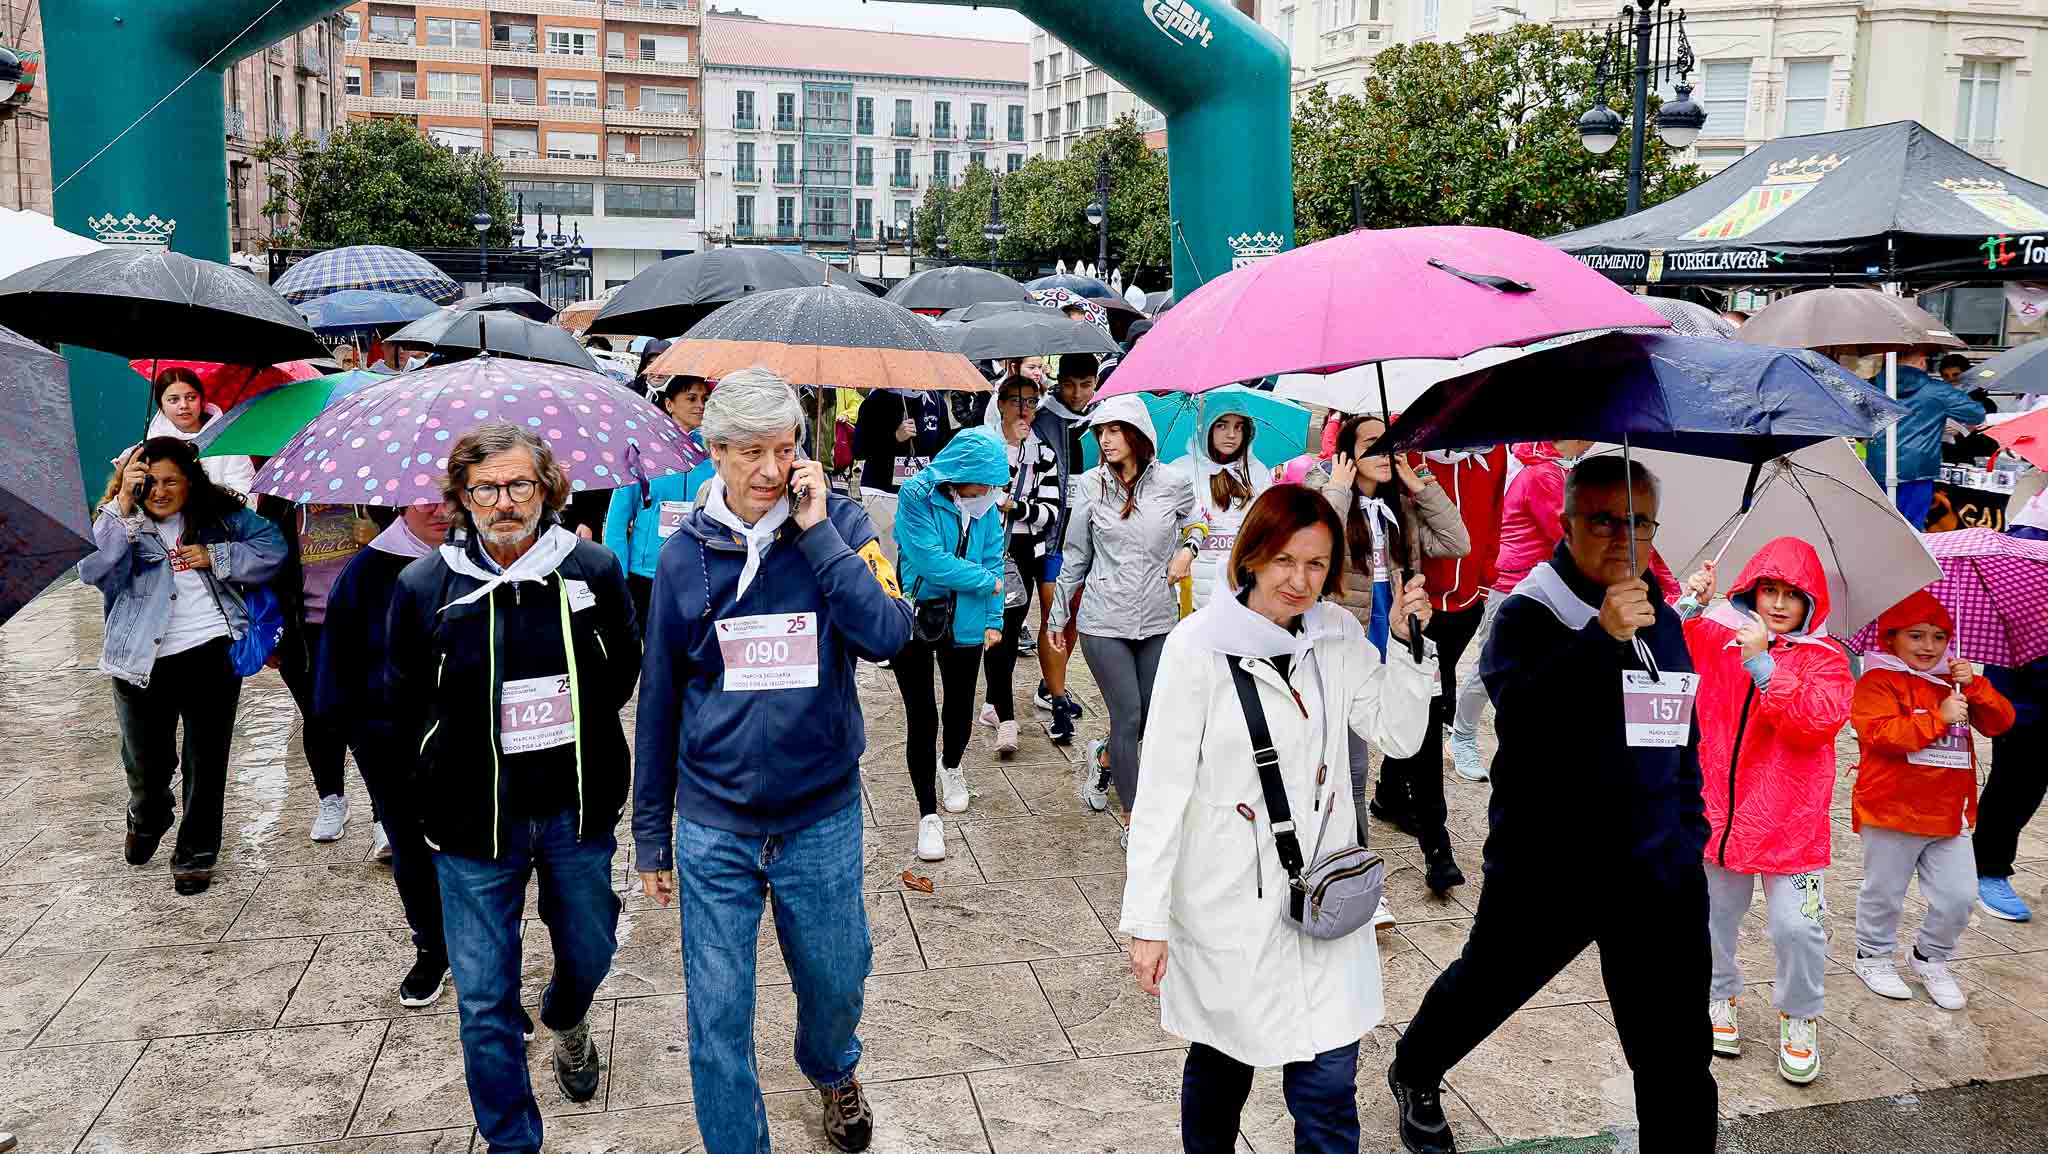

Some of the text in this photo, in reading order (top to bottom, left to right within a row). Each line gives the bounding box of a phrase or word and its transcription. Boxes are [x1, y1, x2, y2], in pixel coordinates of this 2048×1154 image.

[1154, 3, 1214, 48] sport
[1570, 251, 1769, 271] UNTAMIENTO TORRELAVEGA
[1211, 536, 1234, 549] 206
[786, 615, 807, 634] 25
[744, 640, 789, 664] 090
[505, 701, 555, 728] 142
[1649, 697, 1683, 721] 157
